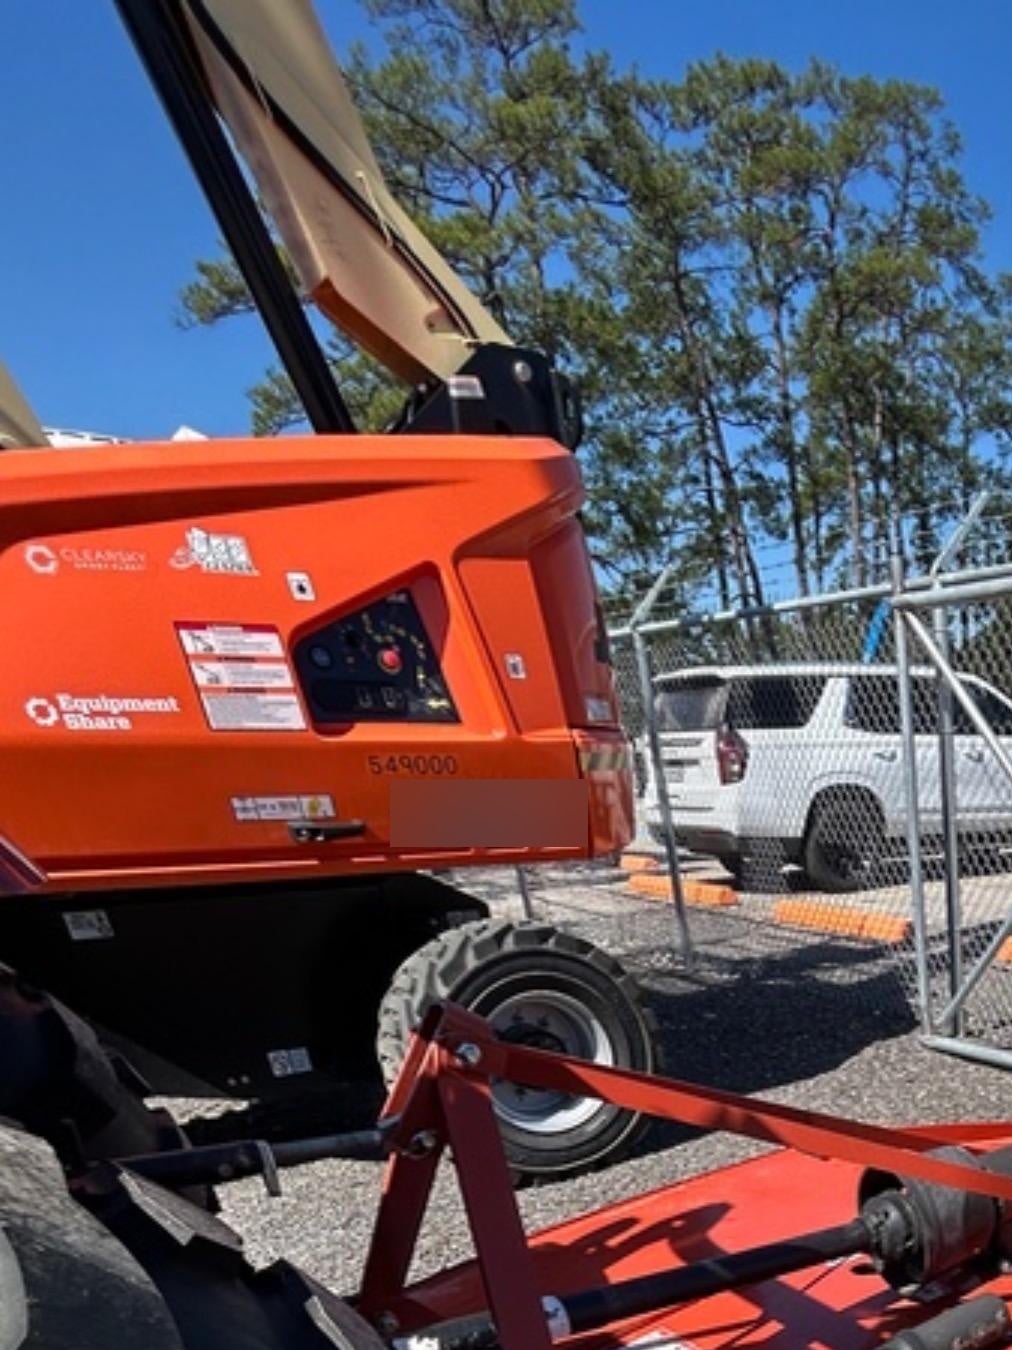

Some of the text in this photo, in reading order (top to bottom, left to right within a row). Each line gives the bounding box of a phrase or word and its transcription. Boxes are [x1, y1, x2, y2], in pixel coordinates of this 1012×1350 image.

[56, 694, 180, 714] Equipment
[62, 713, 132, 730] Share
[368, 755, 457, 775] 549000
